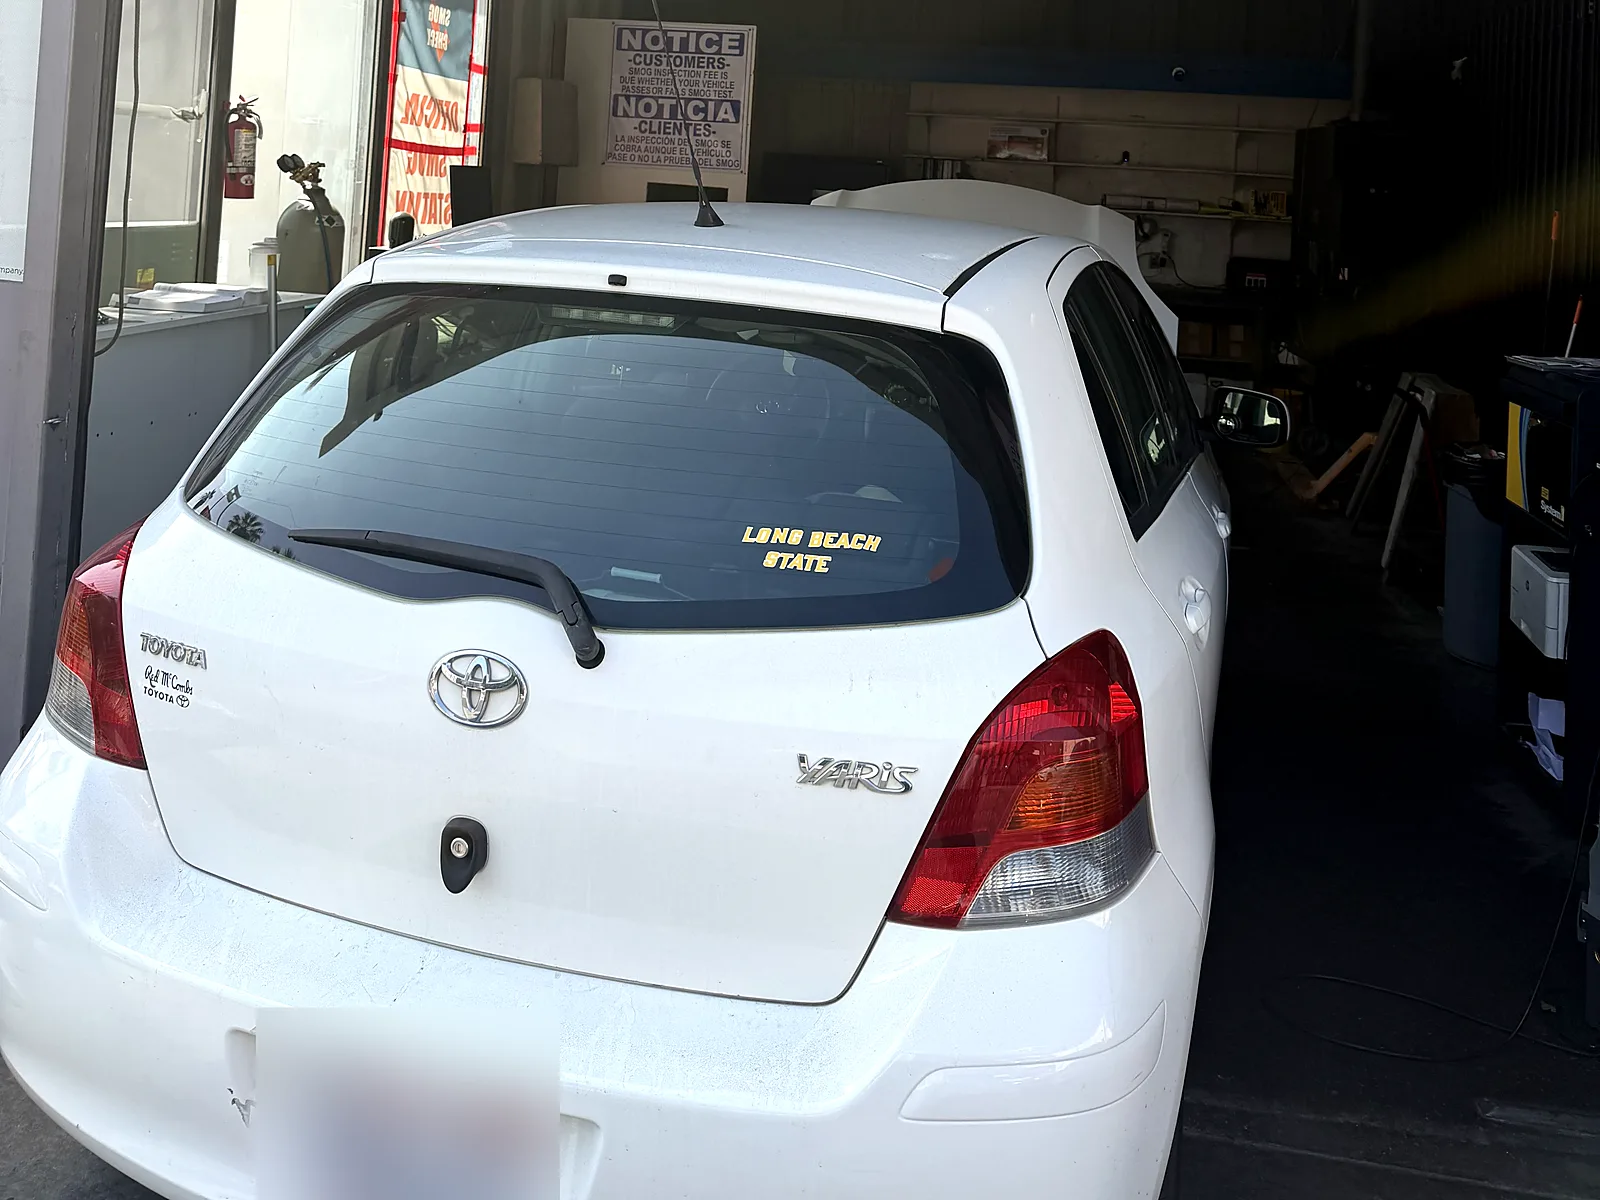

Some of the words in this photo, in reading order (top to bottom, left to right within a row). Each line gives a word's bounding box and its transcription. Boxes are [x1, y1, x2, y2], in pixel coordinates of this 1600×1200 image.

[621, 29, 740, 54] NOTICE
[628, 67, 652, 76] SMOG
[654, 69, 701, 78] INSPECTION
[704, 71, 718, 79] FEE
[620, 76, 635, 84] DUE
[679, 79, 700, 88] YOUR
[702, 80, 734, 89] VEHICLE
[622, 85, 651, 94] PASSES
[665, 87, 686, 96] FAS
[688, 89, 711, 97] SMOG
[713, 90, 734, 98] TEST.
[617, 96, 736, 122] NOTICIA
[614, 144, 642, 153] COBRA
[644, 146, 677, 156] AUNQUE
[678, 138, 690, 146] DE
[695, 139, 718, 148] SMOG
[638, 154, 650, 162] NO
[664, 156, 692, 165] PRUEB
[698, 159, 713, 167] DEL
[716, 159, 740, 168] SMOG
[742, 526, 804, 546] LONG
[808, 531, 882, 552] BEACH
[762, 550, 832, 573] STATE
[140, 632, 207, 670] TOYOTA
[144, 686, 174, 704] TOYOTA
